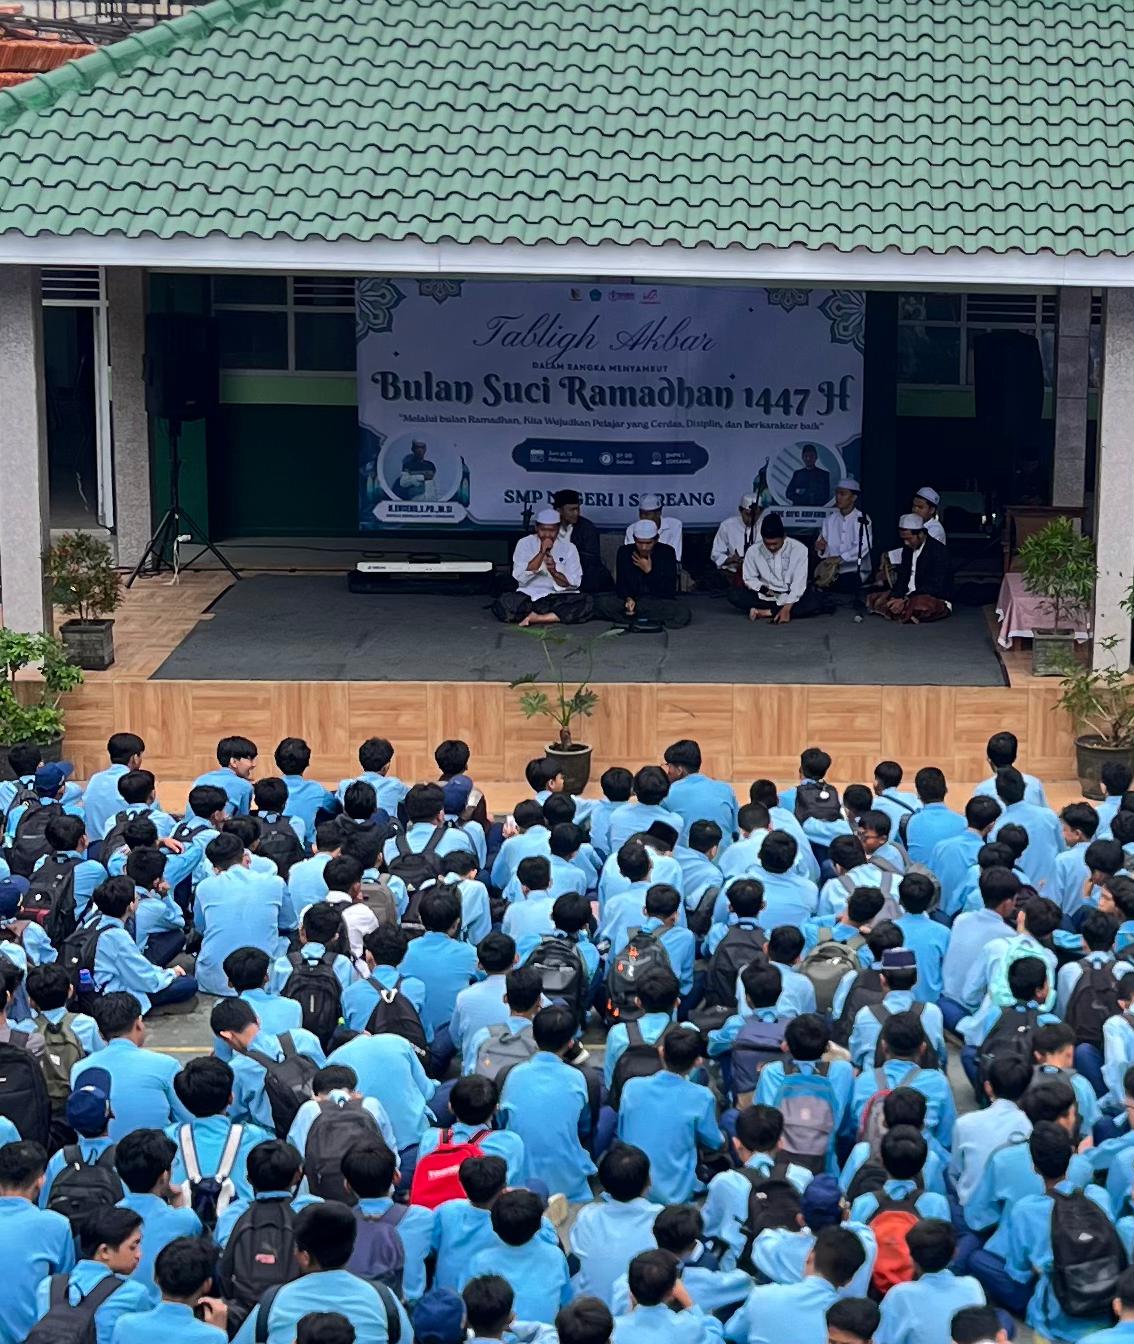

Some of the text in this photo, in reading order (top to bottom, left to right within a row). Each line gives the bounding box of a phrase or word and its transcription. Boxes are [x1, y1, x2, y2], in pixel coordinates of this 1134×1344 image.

[473, 313, 718, 366] Tabligh Akbar
[532, 361, 564, 370] DALAM
[609, 364, 668, 373] MENYAMBUT
[371, 370, 856, 416] Bulan Suci Ramadhan 1447 H
[624, 420, 649, 430] yang
[725, 420, 742, 429] dan
[504, 489, 715, 506] SMP NGERI 1 SREANG
